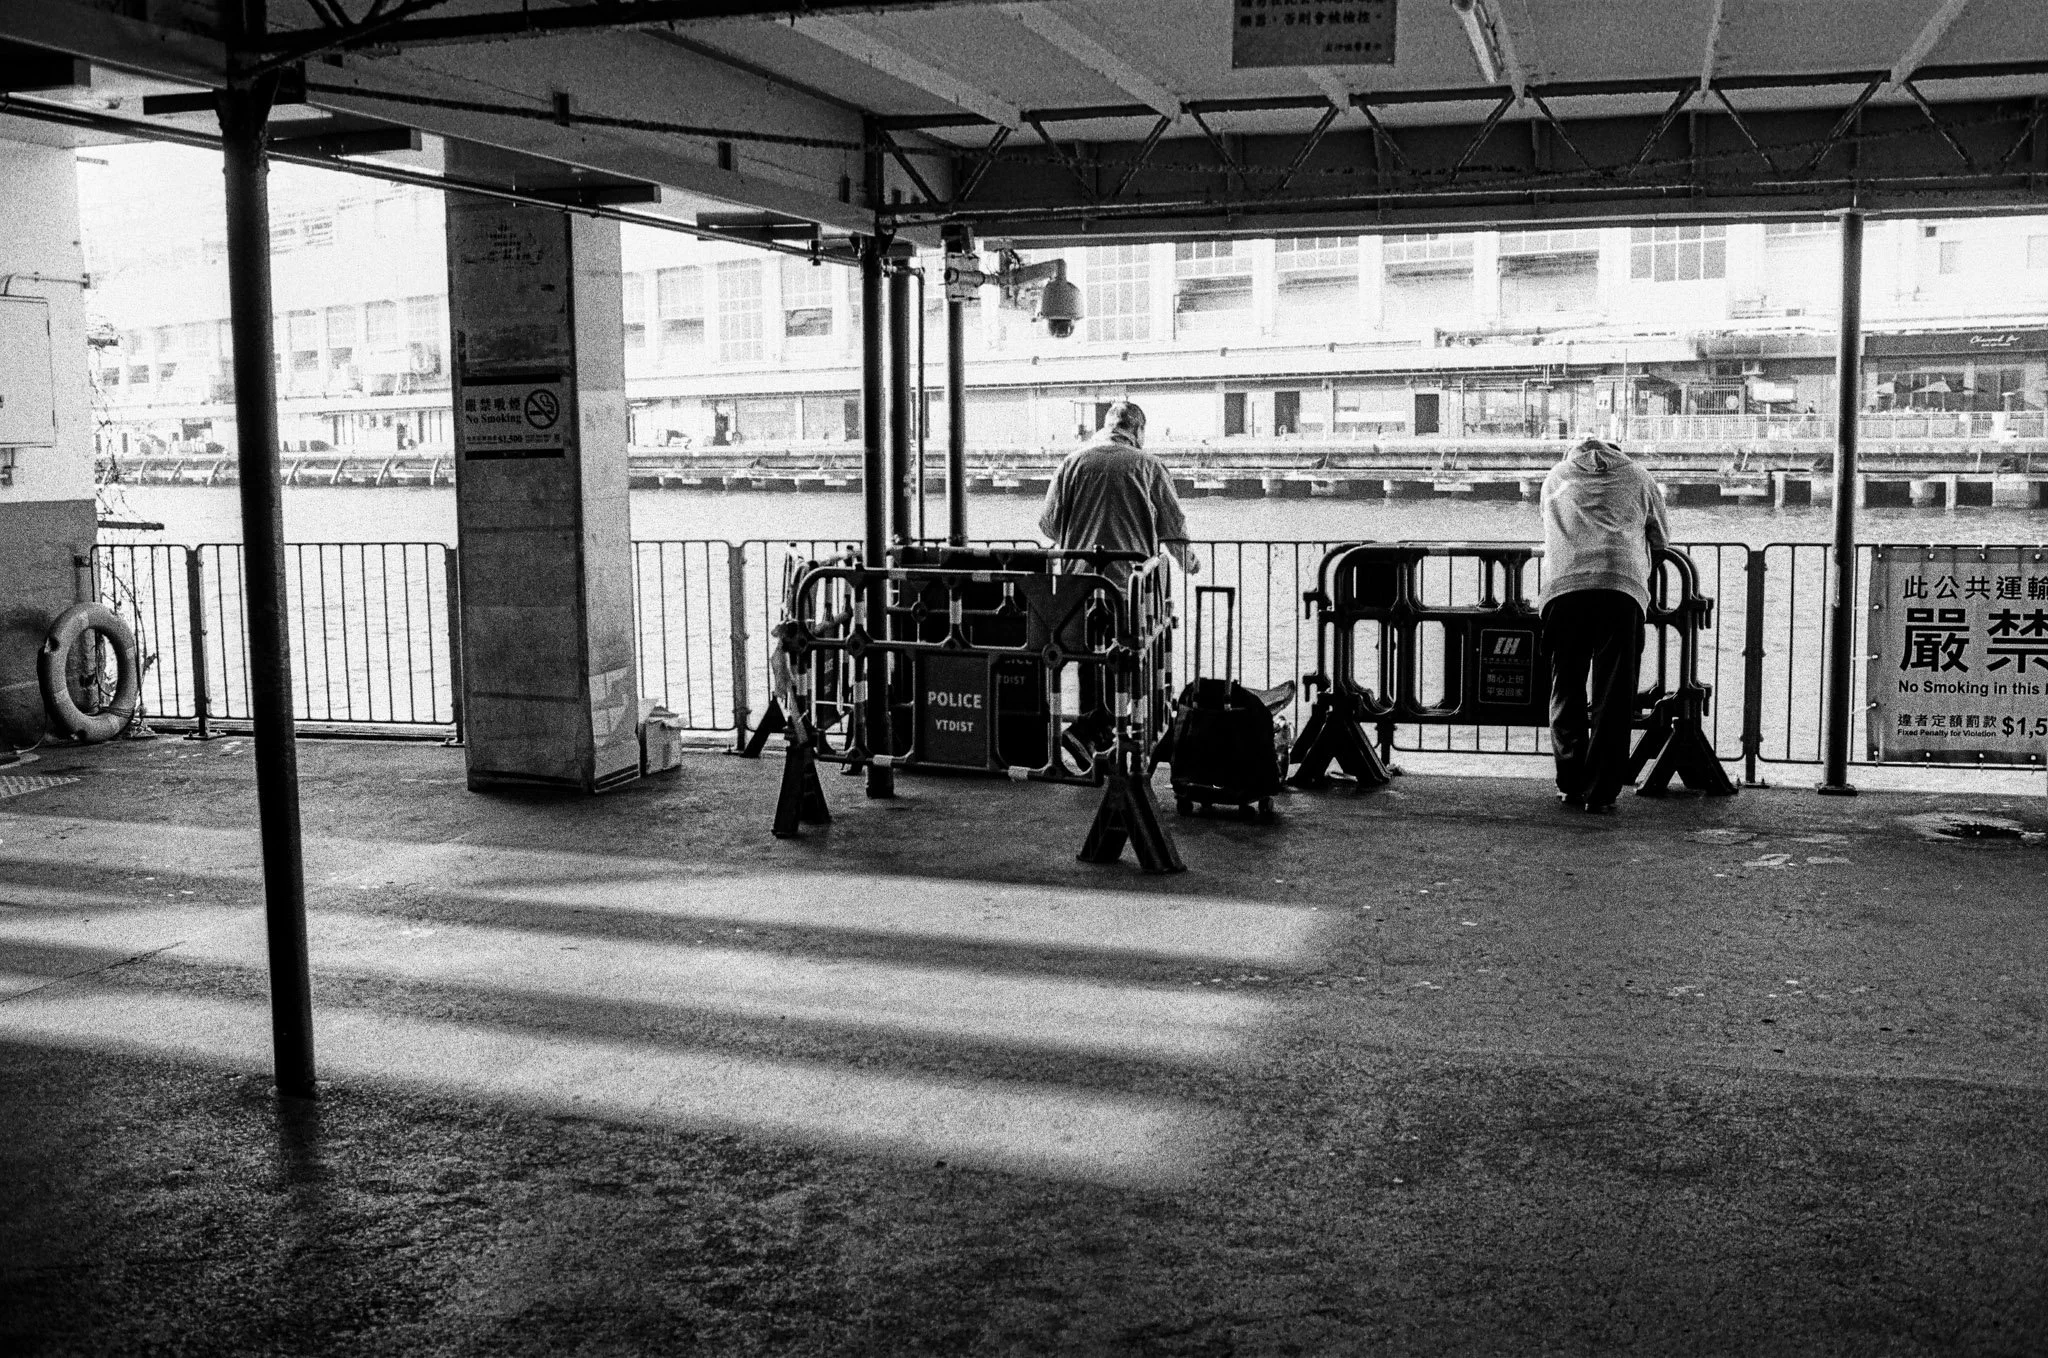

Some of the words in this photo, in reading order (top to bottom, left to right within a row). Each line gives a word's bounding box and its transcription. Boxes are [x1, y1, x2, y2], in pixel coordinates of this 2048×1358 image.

[466, 414, 479, 424] No
[481, 412, 521, 425] Smoking
[1903, 575, 2048, 600] 此公共運輸
[1899, 608, 2048, 673] 嚴禁
[1898, 680, 1919, 693] No
[1923, 680, 1989, 697] Smoking
[1994, 681, 2007, 695] in
[2012, 682, 2040, 695] this
[927, 691, 983, 709] POLICE
[935, 719, 974, 732] YTDIST
[1897, 714, 1997, 728] 違者定額罰款
[1920, 729, 1948, 738] Penalty
